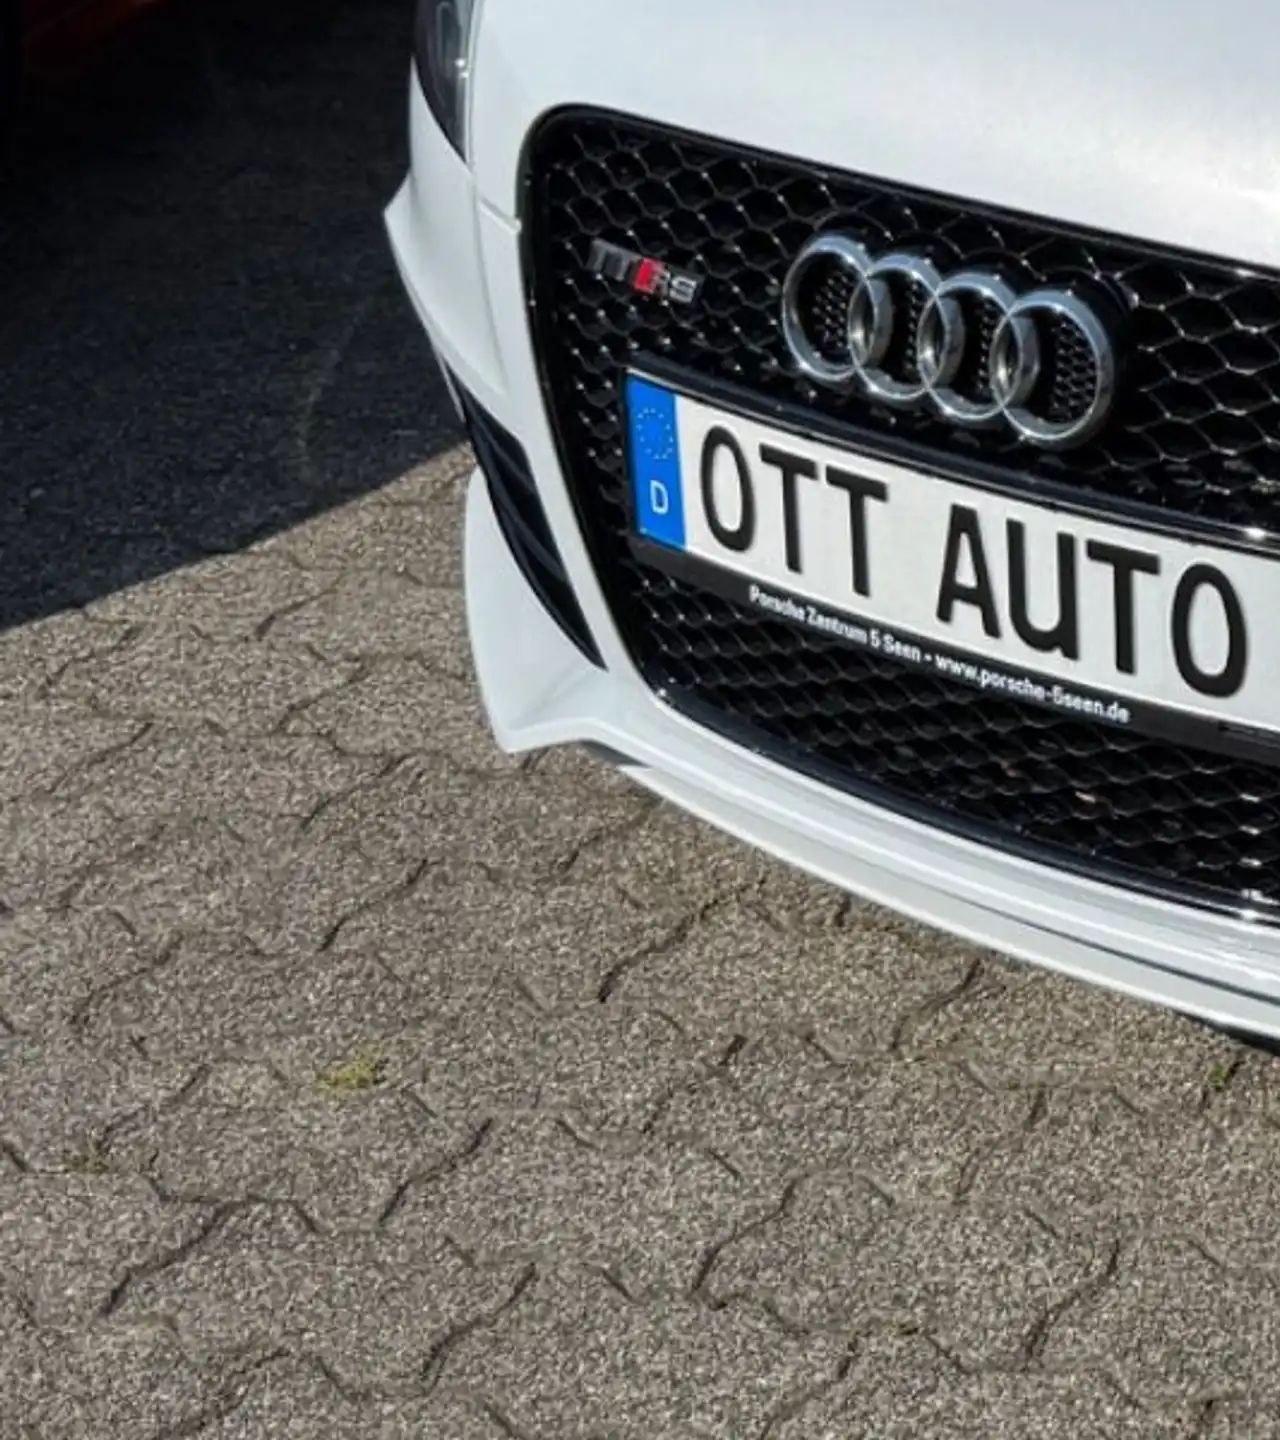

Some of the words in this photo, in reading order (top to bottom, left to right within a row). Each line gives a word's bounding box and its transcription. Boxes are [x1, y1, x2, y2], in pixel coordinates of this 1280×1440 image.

[650, 479, 669, 515] D
[700, 426, 888, 597] OTT
[936, 504, 1248, 699] AUTO
[749, 583, 805, 621] Porsche
[806, 605, 868, 645] Zentrum
[869, 627, 881, 649] 5
[883, 633, 921, 663] Seen
[934, 653, 1131, 724] www.porsche-5seen.de
